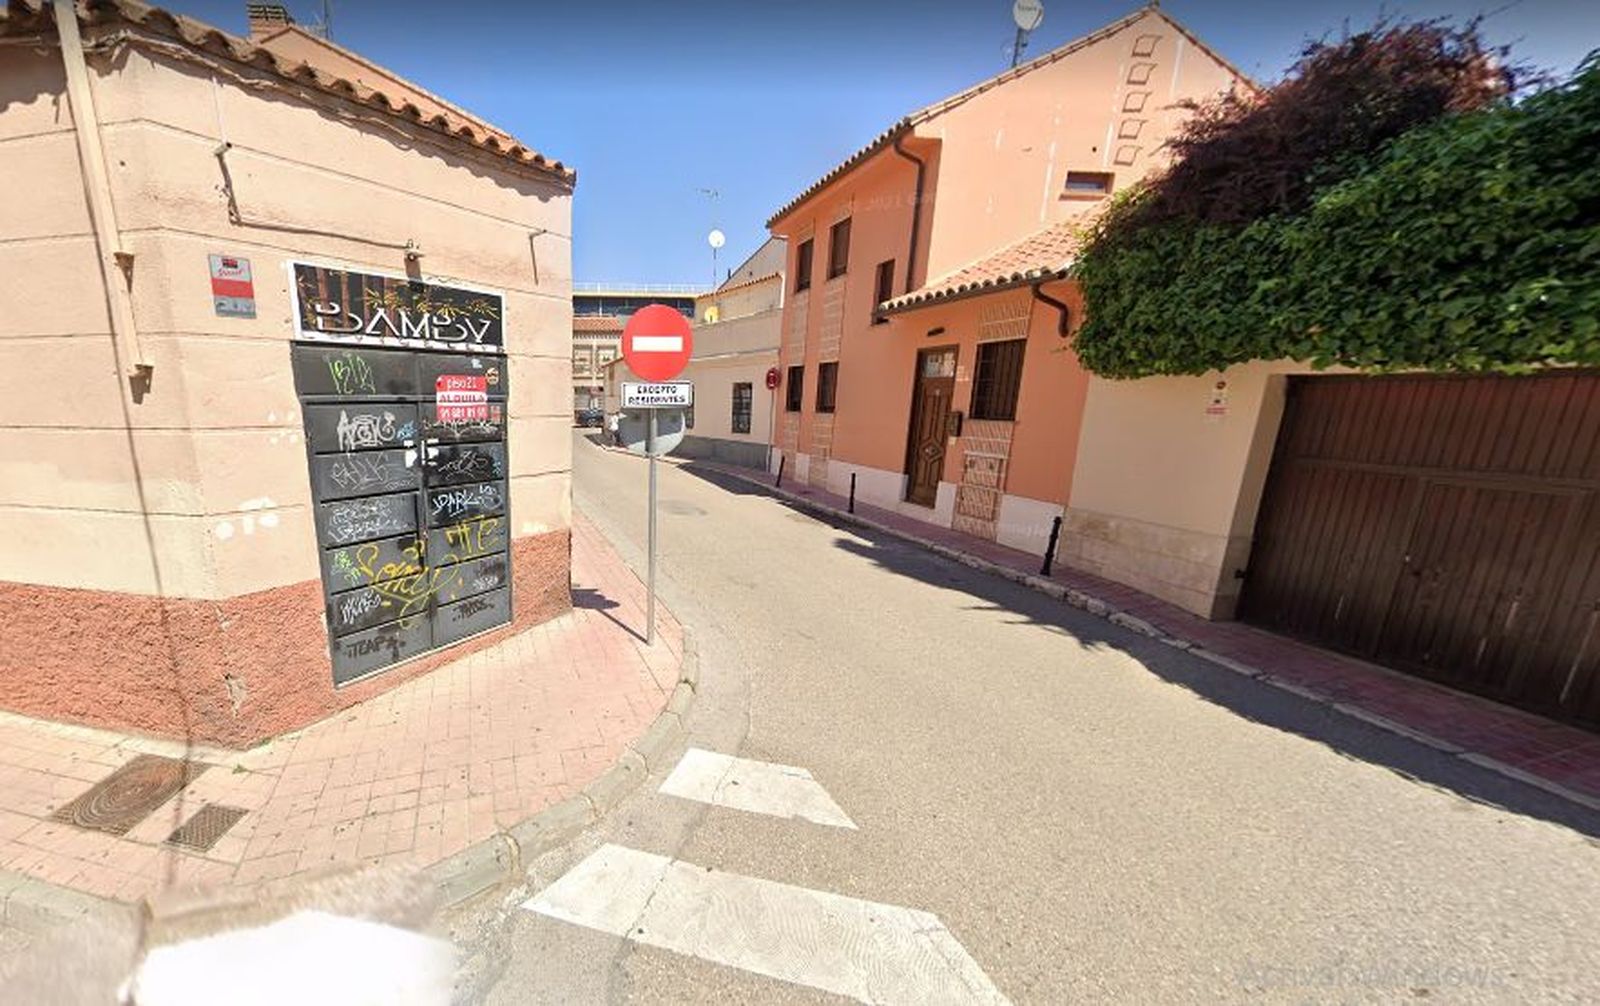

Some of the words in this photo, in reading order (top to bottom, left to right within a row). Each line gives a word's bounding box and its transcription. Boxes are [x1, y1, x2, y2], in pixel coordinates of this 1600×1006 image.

[637, 385, 677, 394] EXCEPTO
[438, 394, 484, 403] ALQUILA
[628, 395, 686, 405] RESIDENTES
